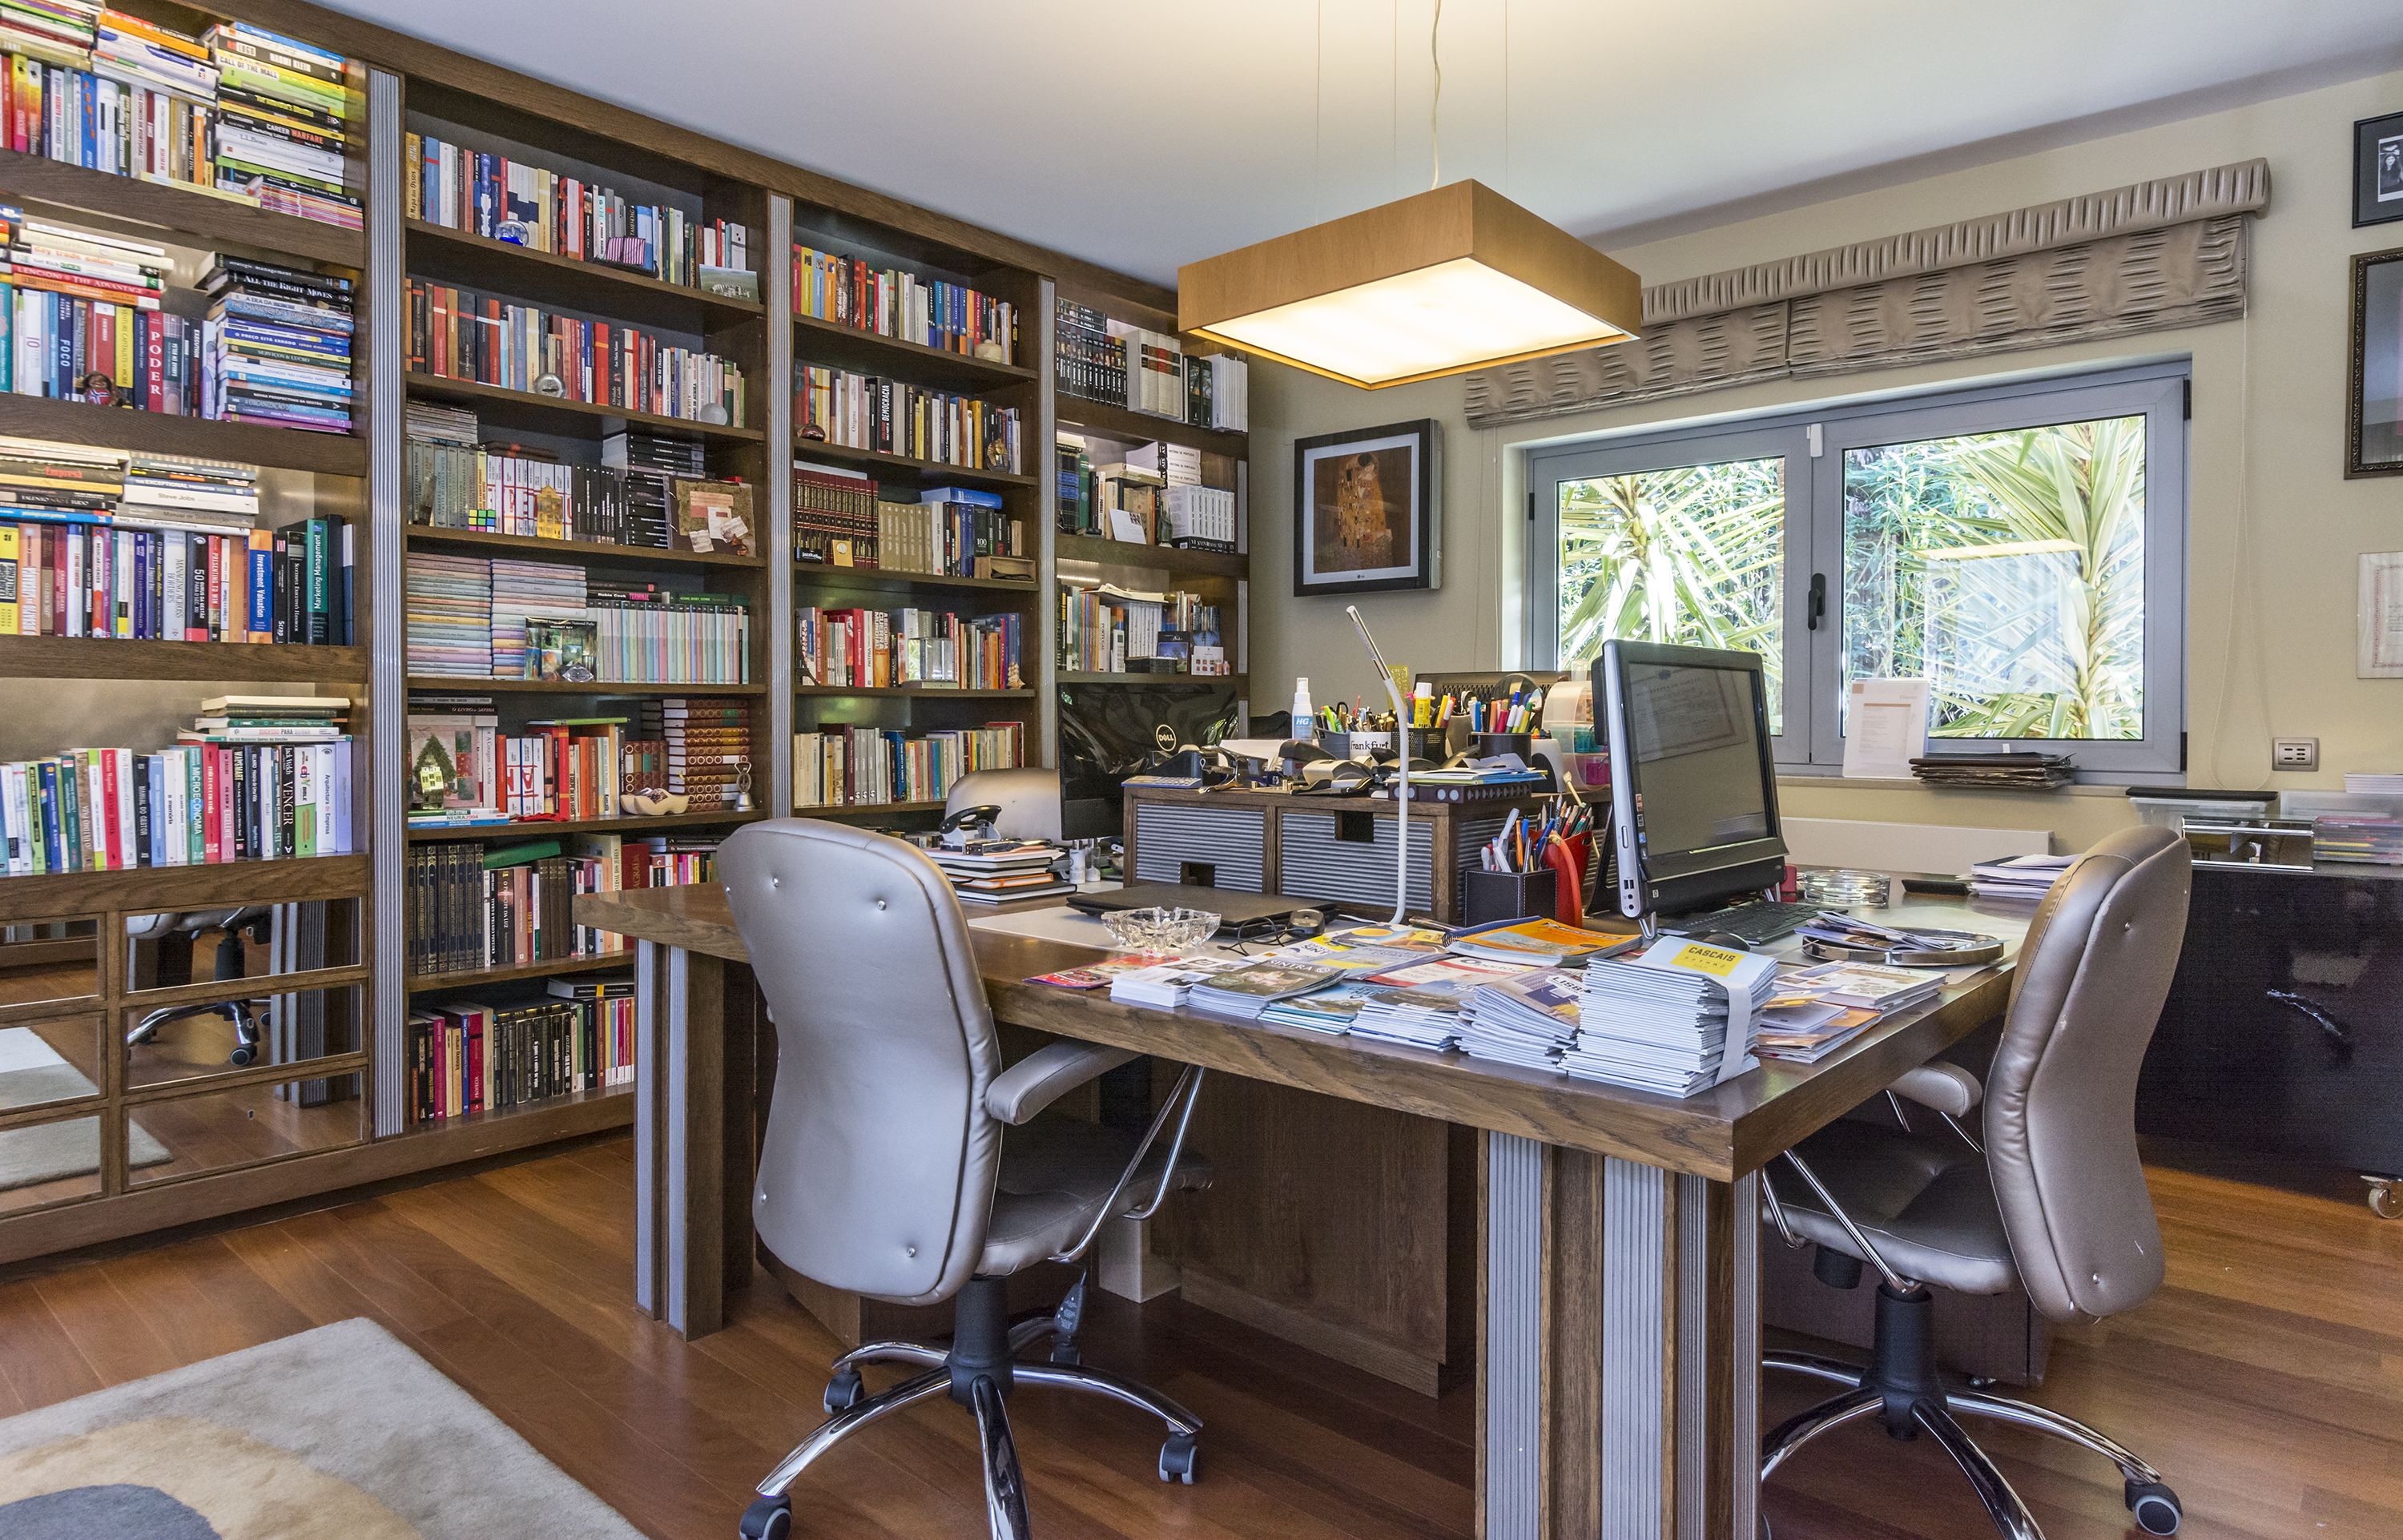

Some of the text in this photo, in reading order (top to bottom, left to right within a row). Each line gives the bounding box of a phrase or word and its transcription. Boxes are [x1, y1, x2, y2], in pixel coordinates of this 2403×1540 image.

[59, 340, 70, 367] FOCO
[150, 332, 162, 396] PODER
[881, 384, 891, 421] DEMOCRACIA
[976, 538, 987, 546] 100
[194, 569, 205, 581] 50
[256, 554, 266, 617] Investment Valuation
[312, 535, 322, 609] Marketing Management
[1296, 718, 1309, 726] HG
[1158, 734, 1174, 742] DELL
[285, 748, 293, 775] Jack Welch
[192, 767, 202, 834] MICROECONOMIA
[284, 781, 293, 825] VENCER
[1269, 959, 1313, 971] SINTRA
[1689, 947, 1736, 963] CASCAIS
